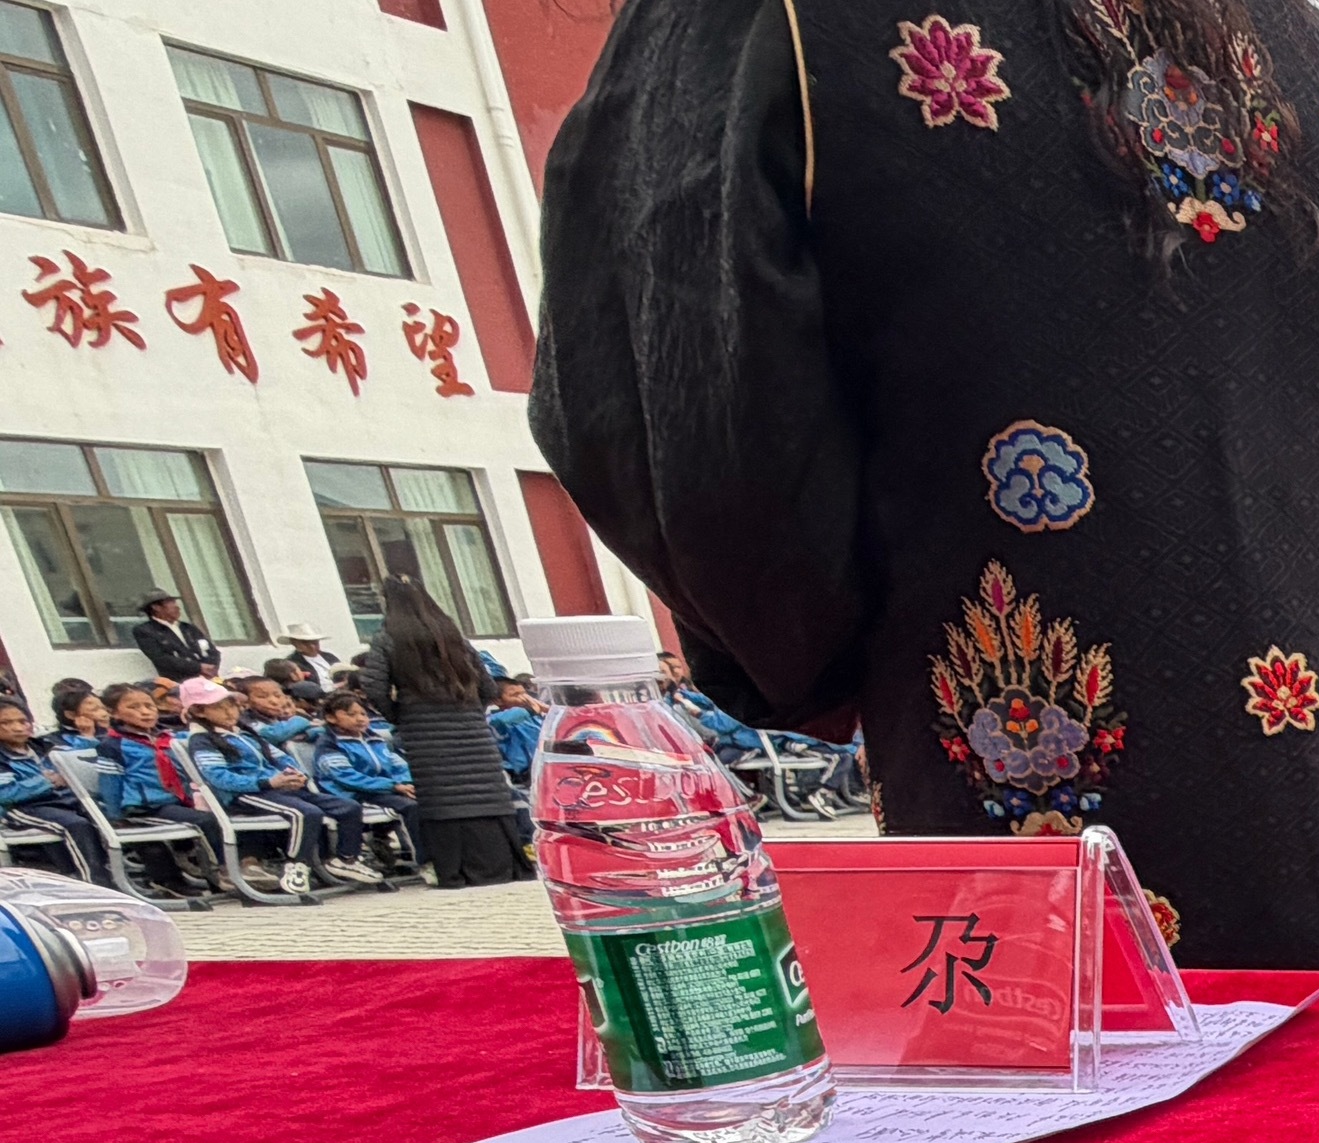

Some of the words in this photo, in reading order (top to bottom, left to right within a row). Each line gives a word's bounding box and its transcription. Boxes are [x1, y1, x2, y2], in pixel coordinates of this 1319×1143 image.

[22, 250, 475, 397] 族有希望
[900, 913, 999, 1015] 尕
